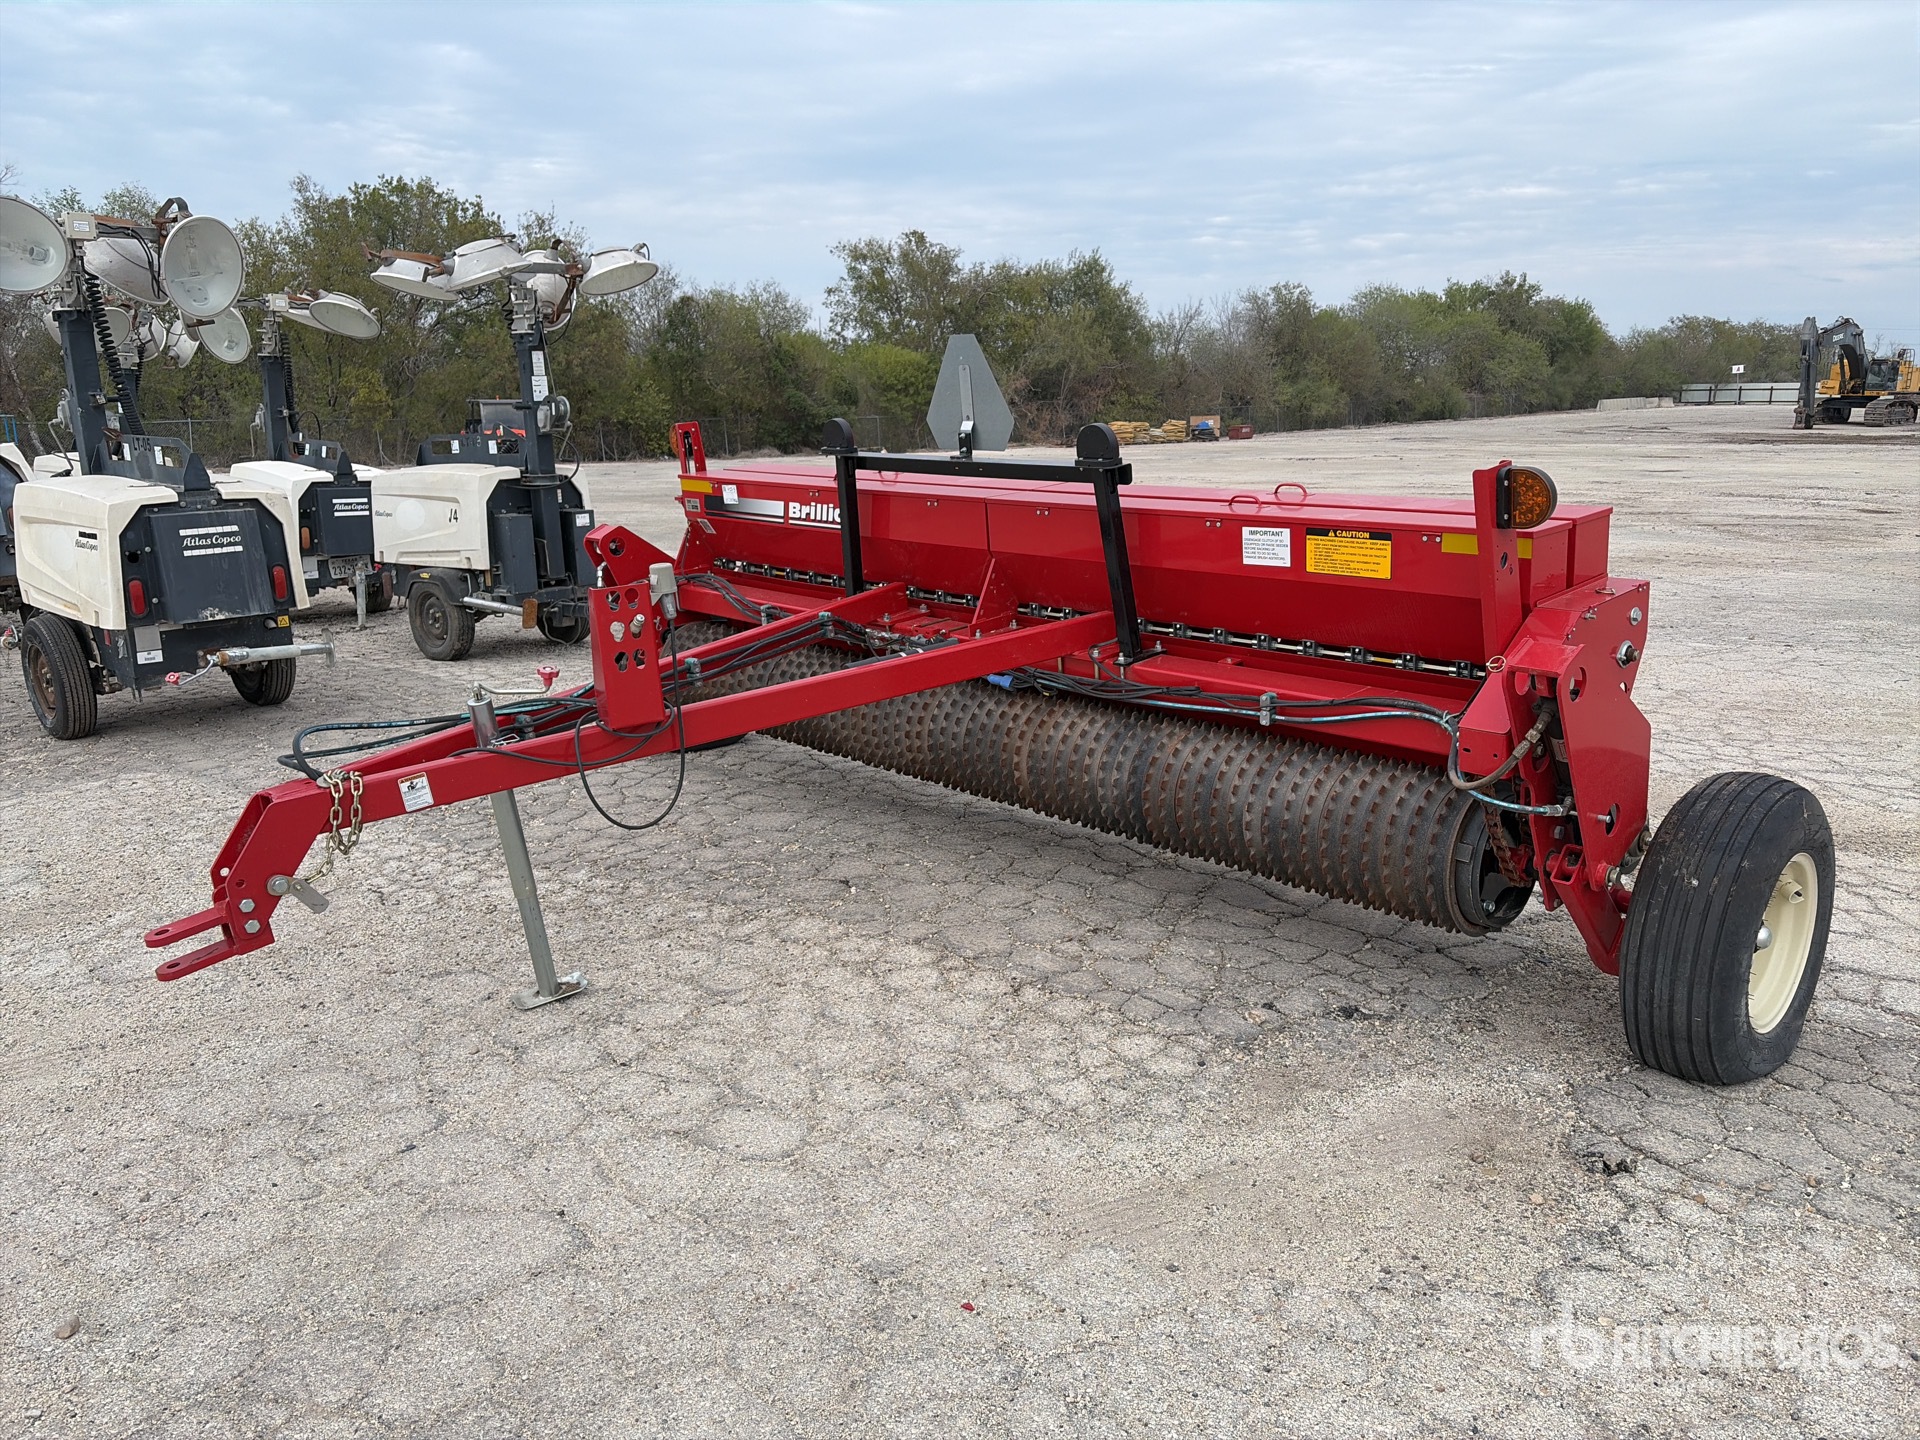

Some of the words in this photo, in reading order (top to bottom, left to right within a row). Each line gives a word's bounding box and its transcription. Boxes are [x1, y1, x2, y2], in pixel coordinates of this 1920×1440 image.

[1336, 530, 1370, 538] CAUTION
[182, 536, 212, 548] Atlas
[212, 535, 242, 545] Copco
